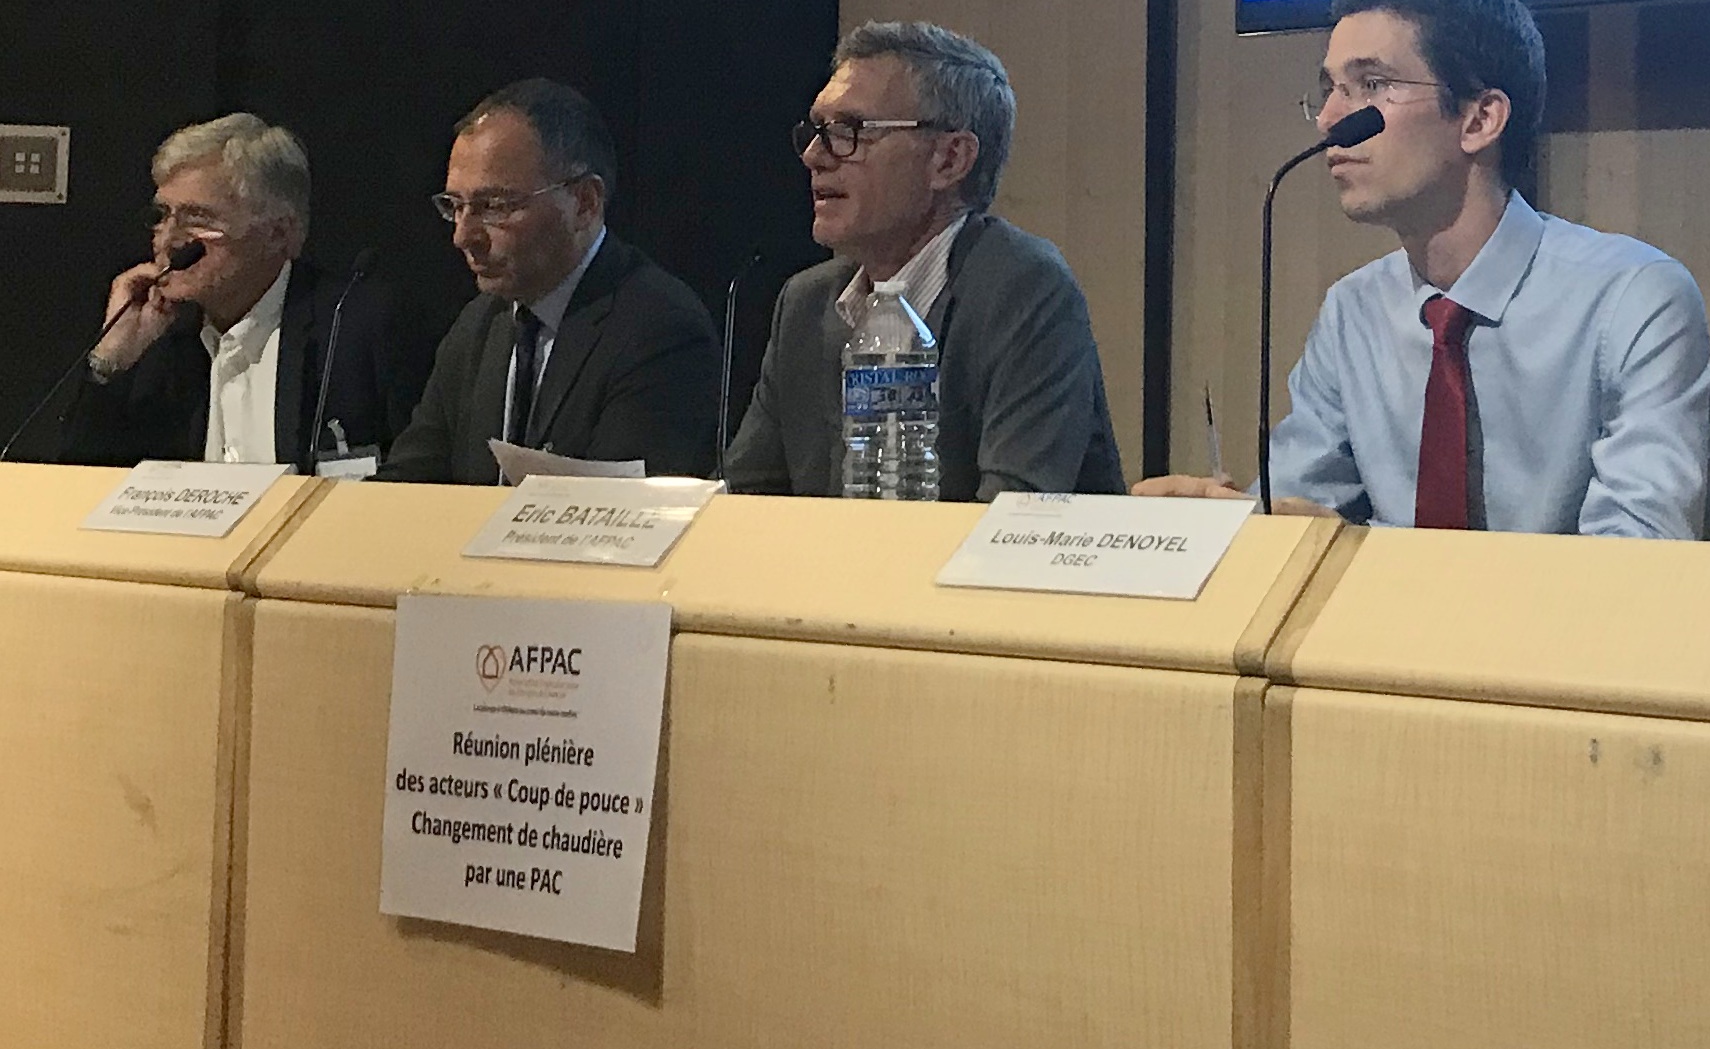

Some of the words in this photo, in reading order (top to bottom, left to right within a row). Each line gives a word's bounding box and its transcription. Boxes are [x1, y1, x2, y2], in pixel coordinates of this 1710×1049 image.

[117, 487, 175, 503] François
[174, 488, 249, 505] DEROCHE
[512, 504, 557, 524] Eric
[990, 528, 1095, 547] Louis-Marie
[1096, 532, 1189, 552] DENOYEL
[1050, 553, 1098, 567] DGEC
[508, 645, 582, 676] AFPAC
[453, 731, 520, 762] Réunion
[524, 736, 594, 767] plénière
[396, 767, 425, 793] des
[429, 773, 489, 800] acteurs
[508, 778, 550, 811] Coup
[554, 782, 575, 808] de
[579, 791, 630, 815] pouce
[411, 810, 514, 845] Changement
[518, 822, 538, 848] de
[542, 825, 623, 860] chaudière
[464, 863, 492, 887] par
[496, 867, 526, 890] une
[530, 867, 564, 895] PAC
